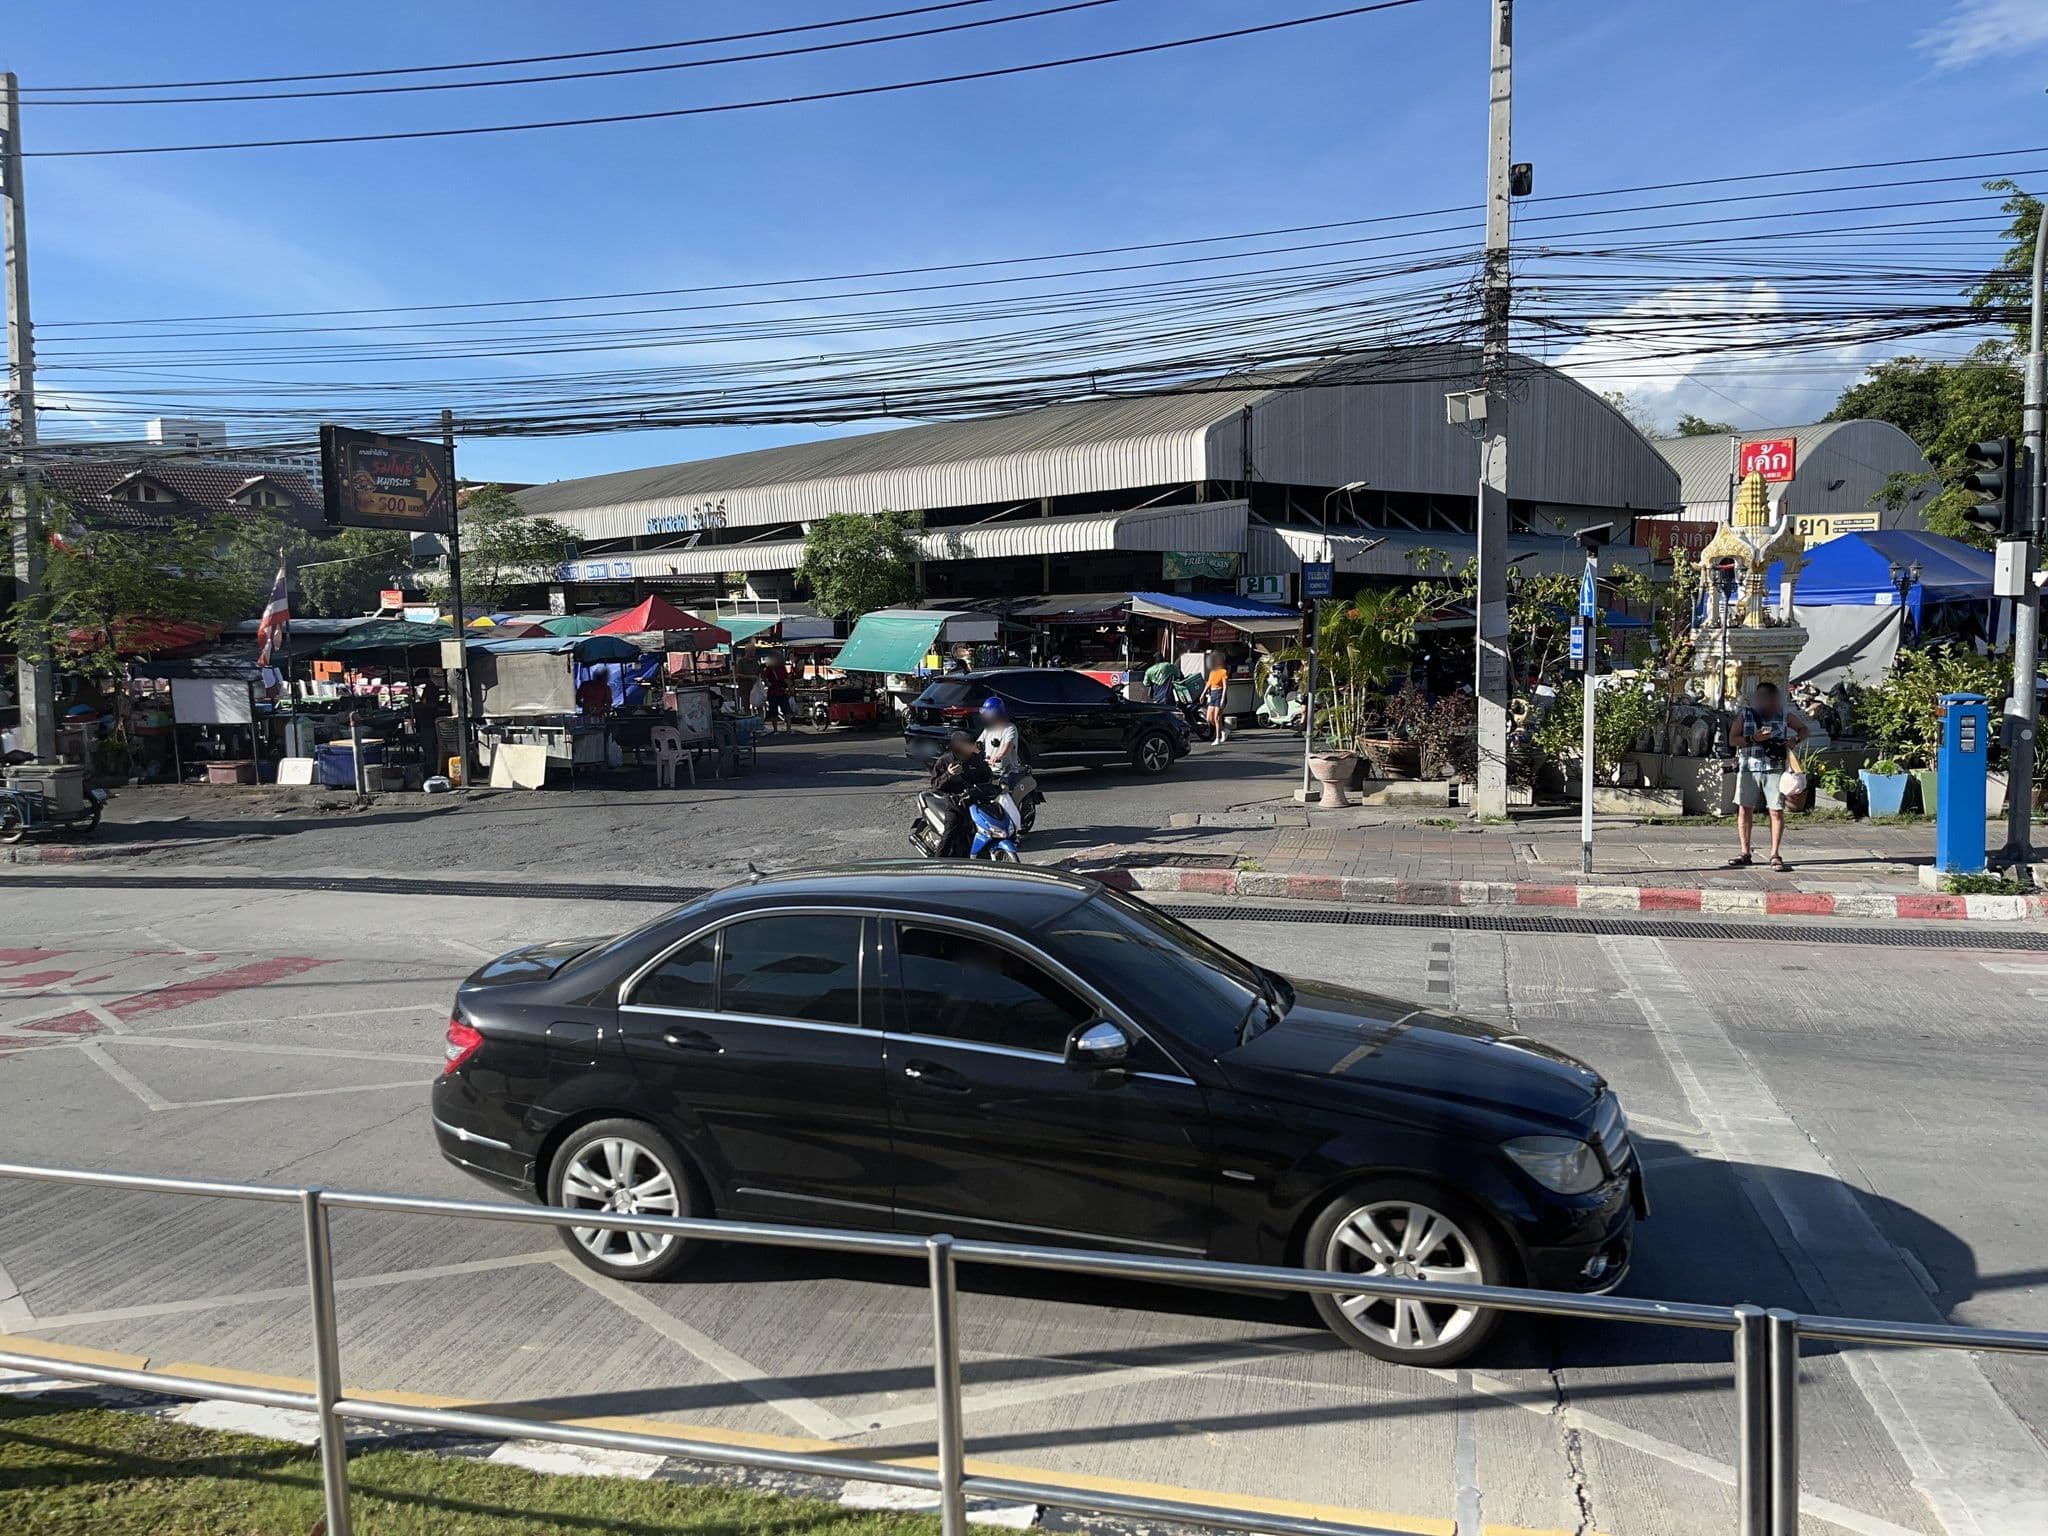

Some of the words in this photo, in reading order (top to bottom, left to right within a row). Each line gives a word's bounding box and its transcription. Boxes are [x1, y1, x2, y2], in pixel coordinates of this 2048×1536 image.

[1747, 443, 1787, 471] เค้ก
[1799, 519, 1829, 536] ยา
[1247, 577, 1278, 593] ยา
